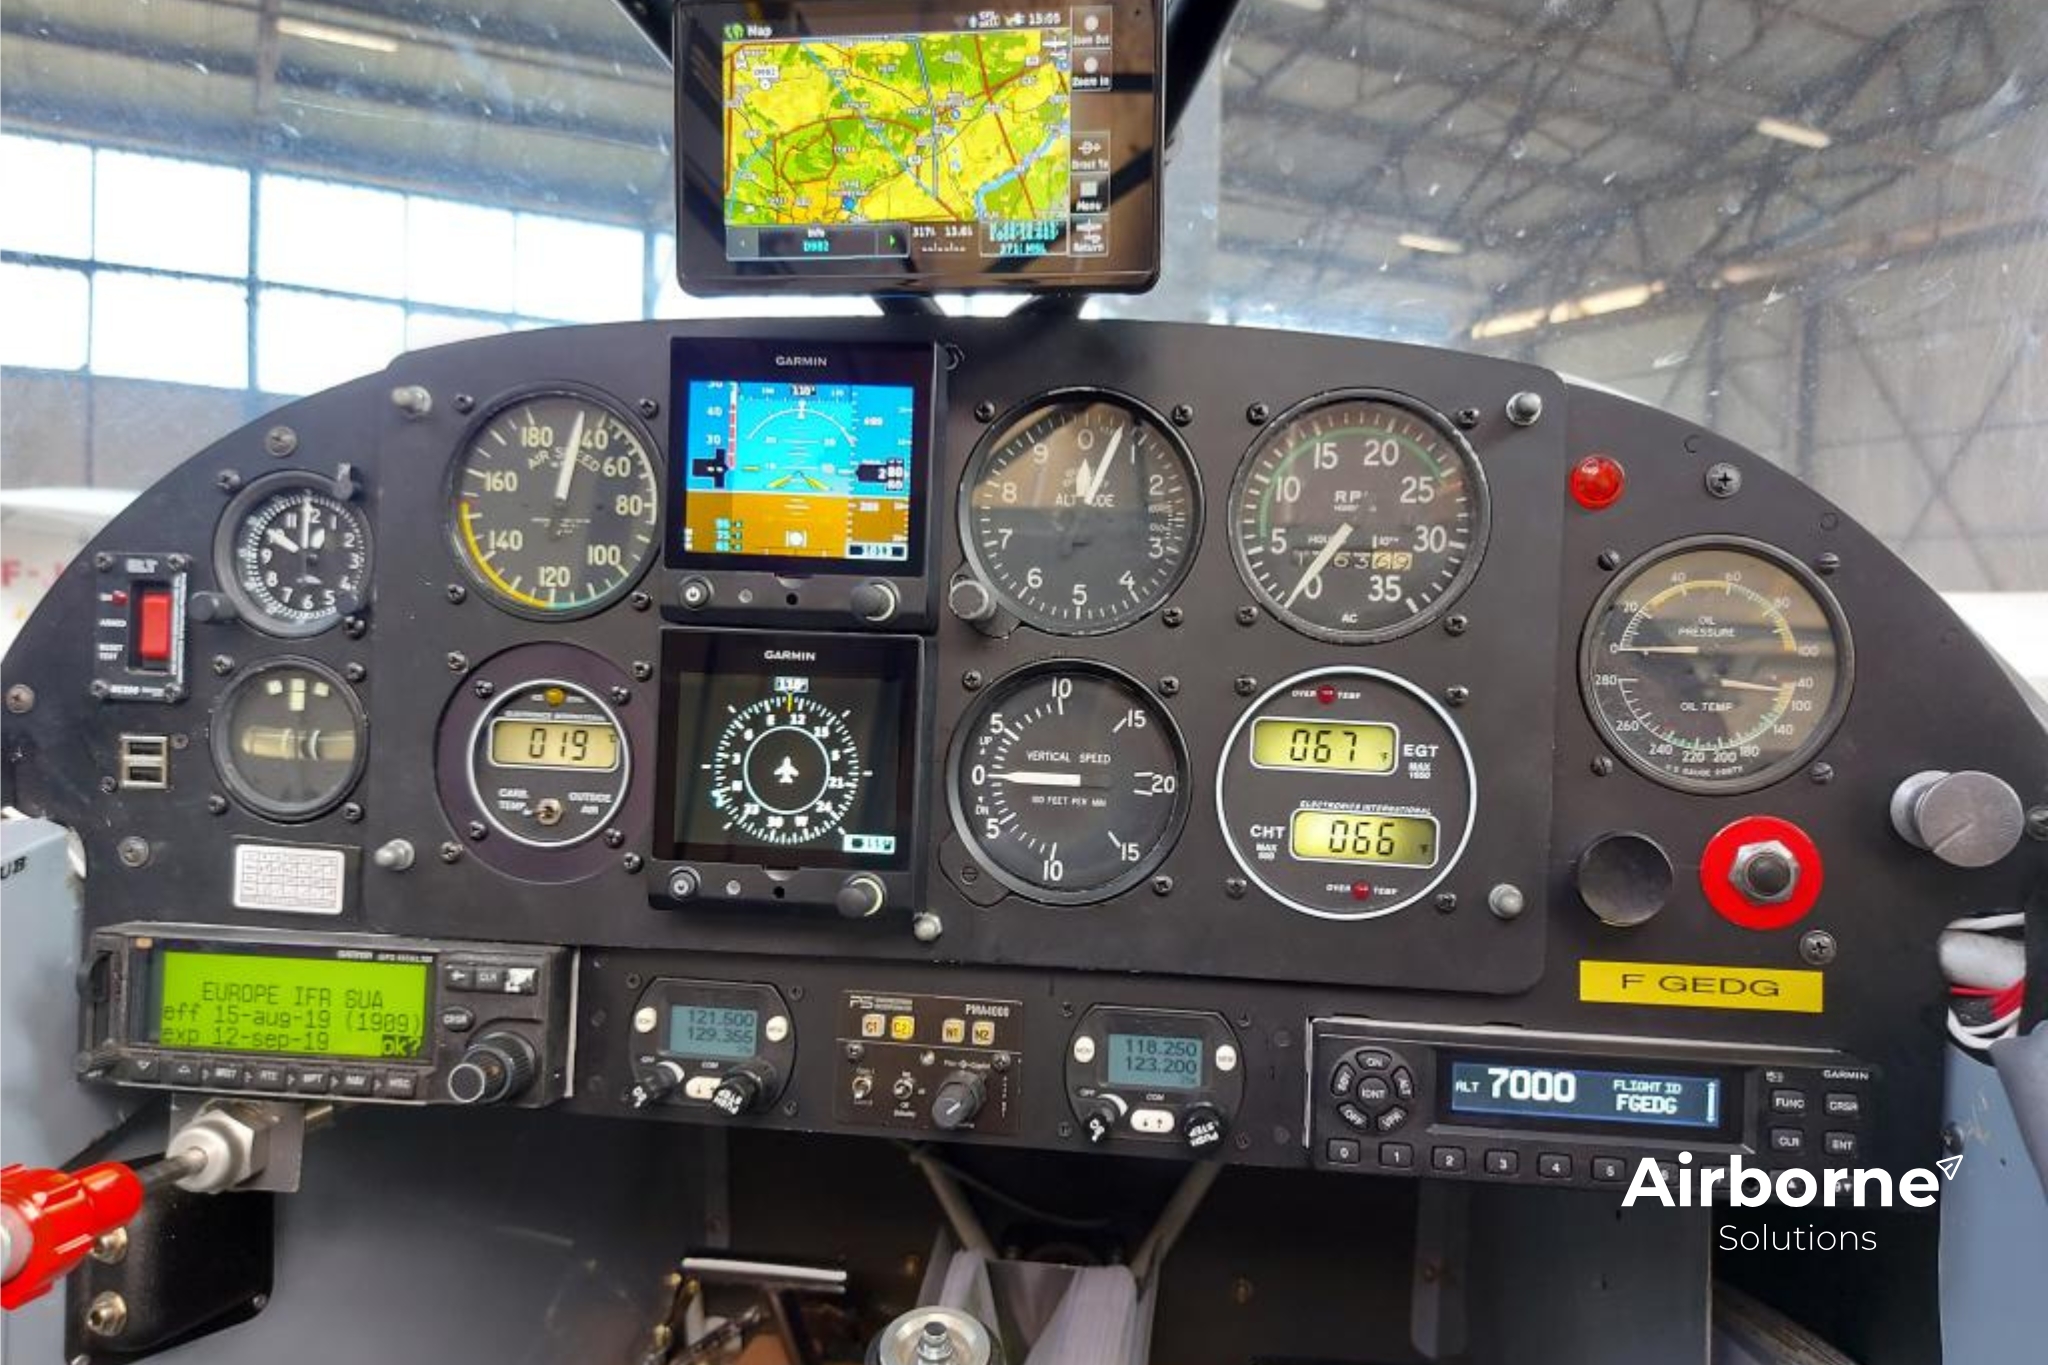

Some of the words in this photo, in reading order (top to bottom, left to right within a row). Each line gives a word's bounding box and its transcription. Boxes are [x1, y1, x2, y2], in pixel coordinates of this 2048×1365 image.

[776, 355, 828, 367] GARMIN
[706, 406, 723, 417] 40
[520, 427, 553, 447] 180
[582, 429, 608, 450] 40
[706, 434, 721, 446] 30
[1077, 429, 1095, 450] 0
[528, 450, 550, 470] AIR
[1033, 445, 1049, 464] 9
[1314, 442, 1339, 469] 15
[1363, 440, 1400, 466] 20
[603, 457, 631, 477] 60
[485, 471, 517, 491] 160
[1150, 475, 1165, 496] 2
[1001, 482, 1018, 503] 8
[1276, 476, 1301, 503] 10
[1400, 477, 1435, 504] 25
[616, 496, 643, 515] 80
[286, 514, 297, 528] 11
[331, 515, 337, 529] 1
[344, 532, 355, 548] 2
[489, 530, 523, 550] 140
[998, 528, 1013, 550] 7
[1271, 528, 1287, 554] 5
[1413, 526, 1447, 552] 30
[1149, 537, 1164, 558] 3
[261, 549, 272, 563] 9
[349, 555, 360, 569] 3
[587, 545, 621, 566] 100
[266, 571, 278, 587] 8
[539, 567, 570, 587] 120
[1027, 568, 1043, 588] 6
[1119, 570, 1135, 590] 4
[1670, 572, 1687, 583] 40
[1725, 572, 1743, 583] 60
[1304, 574, 1323, 599] 0
[1368, 575, 1402, 601] 35
[282, 587, 293, 602] 7
[303, 595, 313, 609] 6
[324, 590, 336, 606] 5
[1072, 584, 1087, 606] 5
[1341, 613, 1359, 623] AC
[1698, 616, 1716, 626] OIL
[1677, 627, 1737, 638] PRESSURE
[764, 650, 817, 662] GARMIN
[1610, 644, 1620, 655] 0
[1797, 646, 1819, 657] 100
[1595, 674, 1619, 686] 280
[1052, 677, 1073, 699] 10
[1292, 690, 1318, 699] OVER
[1337, 691, 1361, 700] TEMP
[1680, 702, 1699, 712] OIL
[1702, 702, 1733, 712] TEMP
[1791, 701, 1812, 712] 100
[990, 714, 1004, 734] 5
[1127, 709, 1147, 728] 15
[1616, 720, 1639, 731] 260
[1773, 724, 1794, 735] 140
[529, 728, 588, 760] 019
[979, 736, 993, 746] UP
[1289, 728, 1358, 763] 067
[1026, 750, 1071, 763] VERTICAL
[1079, 754, 1111, 765] SPEED
[1403, 744, 1439, 758] EGT
[1649, 744, 1673, 756] 240
[1682, 751, 1705, 763] 220
[1713, 751, 1737, 763] 200
[1408, 762, 1431, 771] MAX
[971, 765, 986, 786] 0
[1151, 775, 1176, 794] 20
[568, 792, 612, 803] OUTSIDE
[1047, 796, 1067, 806] FEET
[1072, 798, 1087, 807] PER
[1092, 799, 1108, 808] MIN
[580, 805, 599, 815] AIR
[975, 805, 989, 816] DN
[985, 818, 1000, 839] 5
[1250, 824, 1286, 839] CHT
[1328, 820, 1395, 856] 066
[1121, 843, 1140, 861] 15
[1256, 843, 1278, 852] MAX
[1043, 860, 1063, 882] 10
[1325, 884, 1351, 893] OVER
[1373, 887, 1398, 896] TEMP
[479, 972, 498, 982] CLR
[1622, 973, 1644, 991] F
[1658, 975, 1782, 1000] GEDG
[202, 982, 279, 1006] EUROPE
[296, 985, 332, 1009] IFR
[345, 989, 385, 1010] SUA
[162, 1003, 201, 1023] eff
[213, 1006, 332, 1031] 15-aug-19
[346, 1013, 421, 1036] (1909)
[688, 1009, 754, 1027] 121.500
[865, 1021, 878, 1034] C1
[162, 1028, 201, 1047] exp
[212, 1029, 331, 1053] 12-sep-19
[1125, 1039, 1198, 1057] 118.250
[1125, 1056, 1198, 1075] 123.200
[1366, 1057, 1383, 1068] ON
[1823, 1069, 1869, 1081] GARMIN
[1455, 1080, 1480, 1093] ALT
[1487, 1068, 1576, 1103] 7000
[1613, 1079, 1662, 1094] FLIGHT
[1665, 1083, 1682, 1095] ID
[1146, 1093, 1165, 1101] COM
[1616, 1094, 1679, 1114] FGEDG
[1775, 1097, 1805, 1109] FUNC
[1829, 1101, 1858, 1112] CRSR
[1779, 1136, 1800, 1148] CLR
[1831, 1139, 1853, 1151] ENT
[1393, 1151, 1400, 1163] 1
[1445, 1155, 1455, 1167] 2
[1500, 1158, 1508, 1170] 3
[1551, 1162, 1561, 1173] 4
